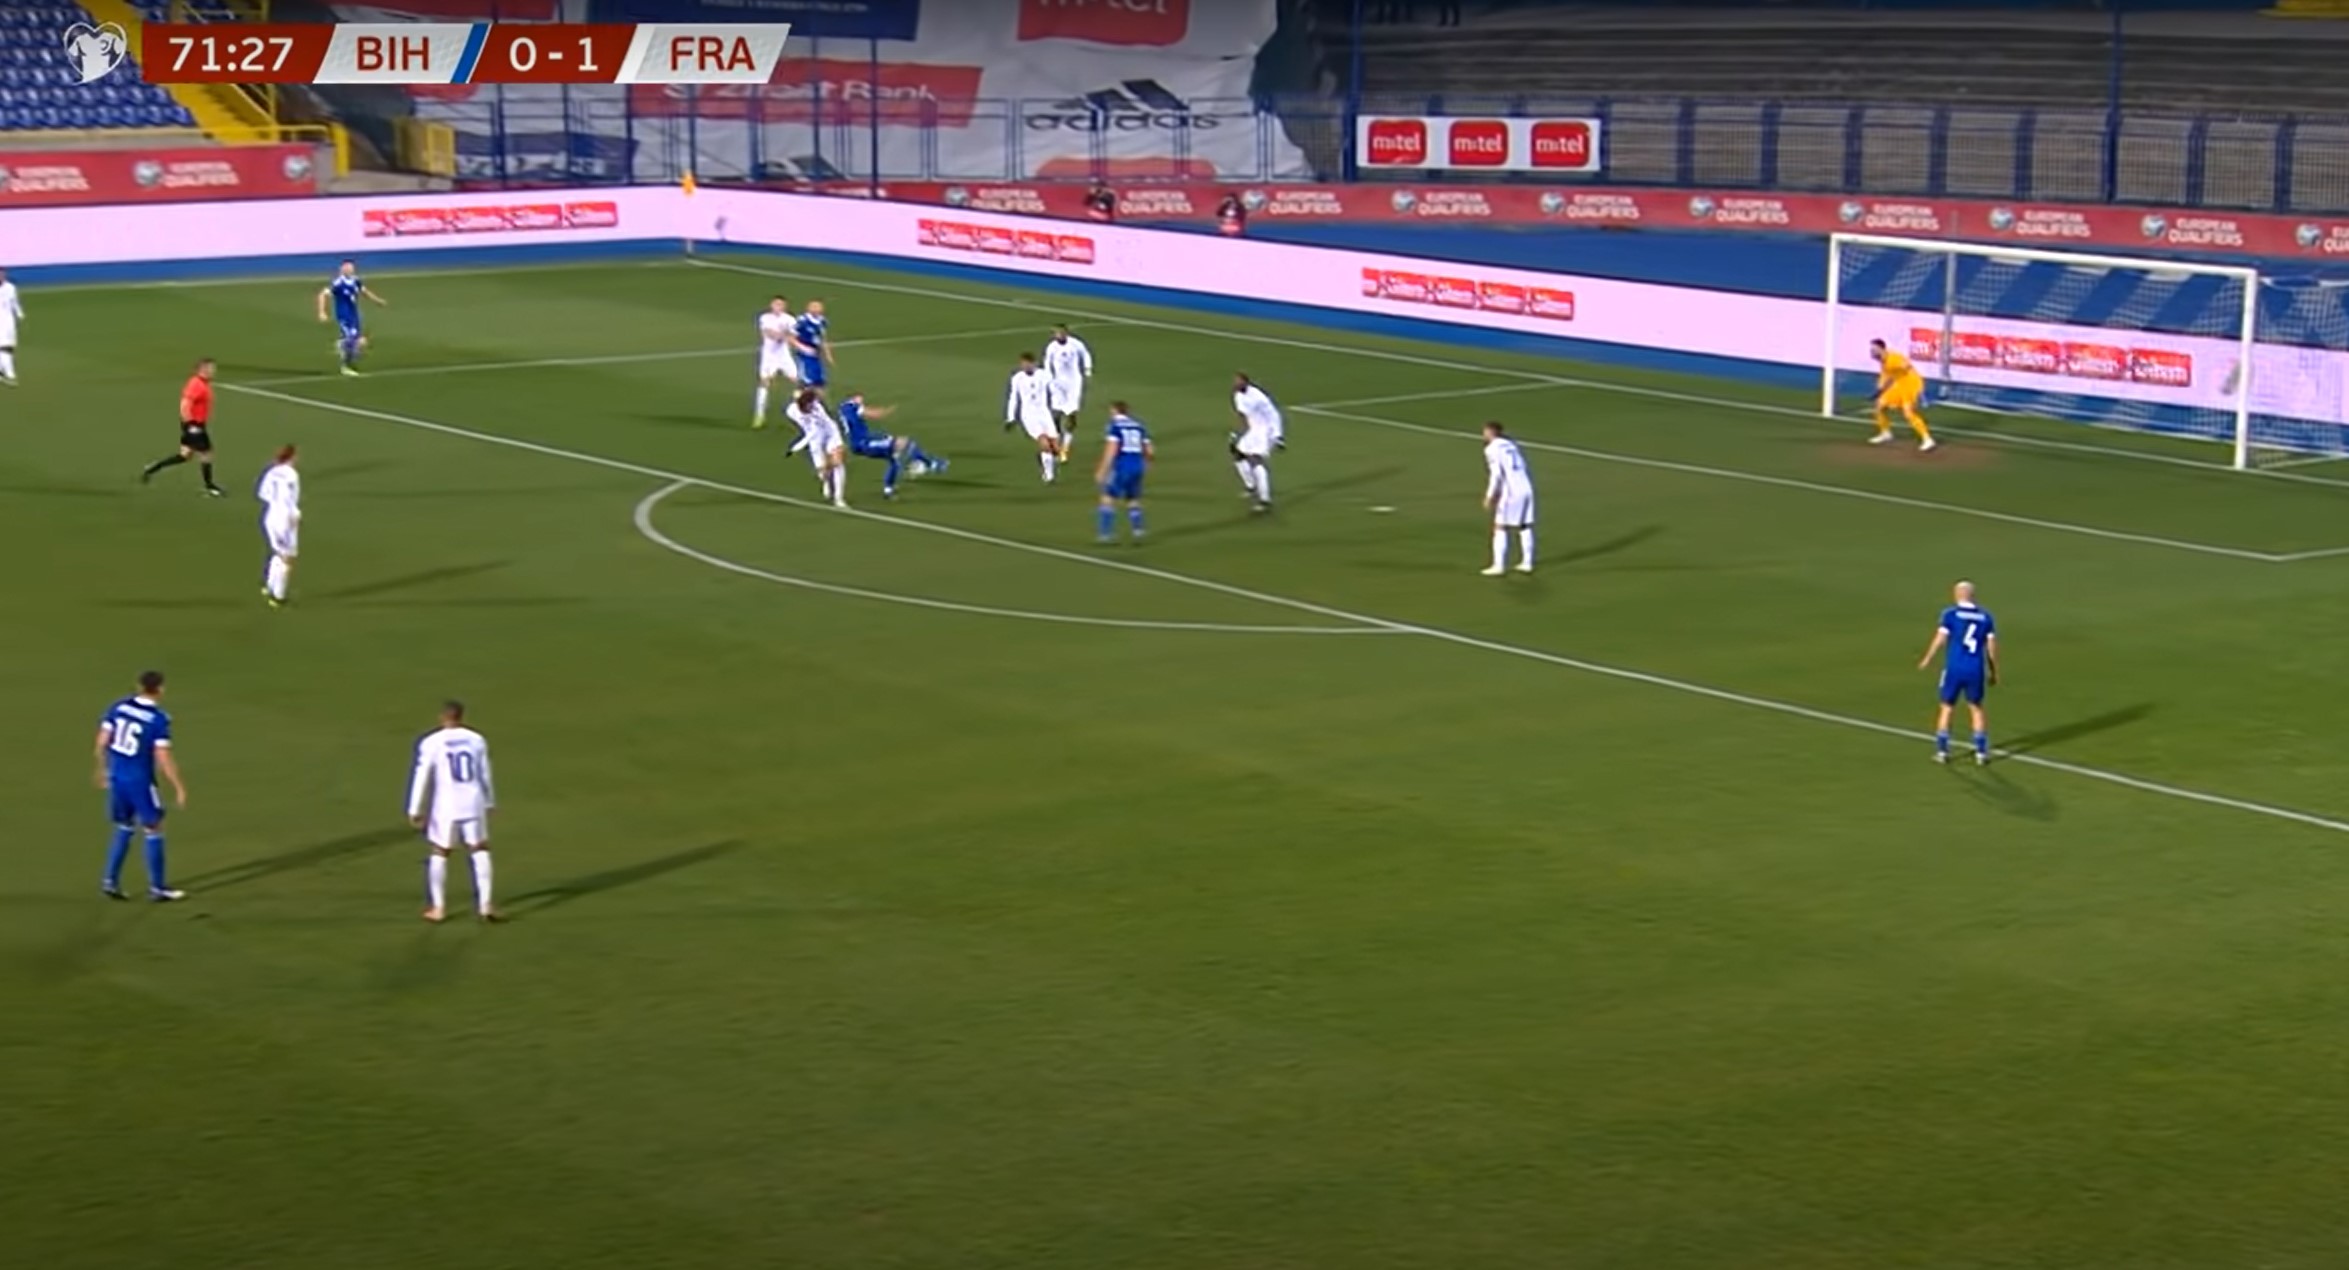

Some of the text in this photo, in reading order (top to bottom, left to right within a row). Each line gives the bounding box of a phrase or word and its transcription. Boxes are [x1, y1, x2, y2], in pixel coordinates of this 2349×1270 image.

[1026, 108, 1220, 132] adidas
[1963, 623, 1977, 653] 4
[111, 717, 143, 757] 16
[446, 750, 475, 783] 10
